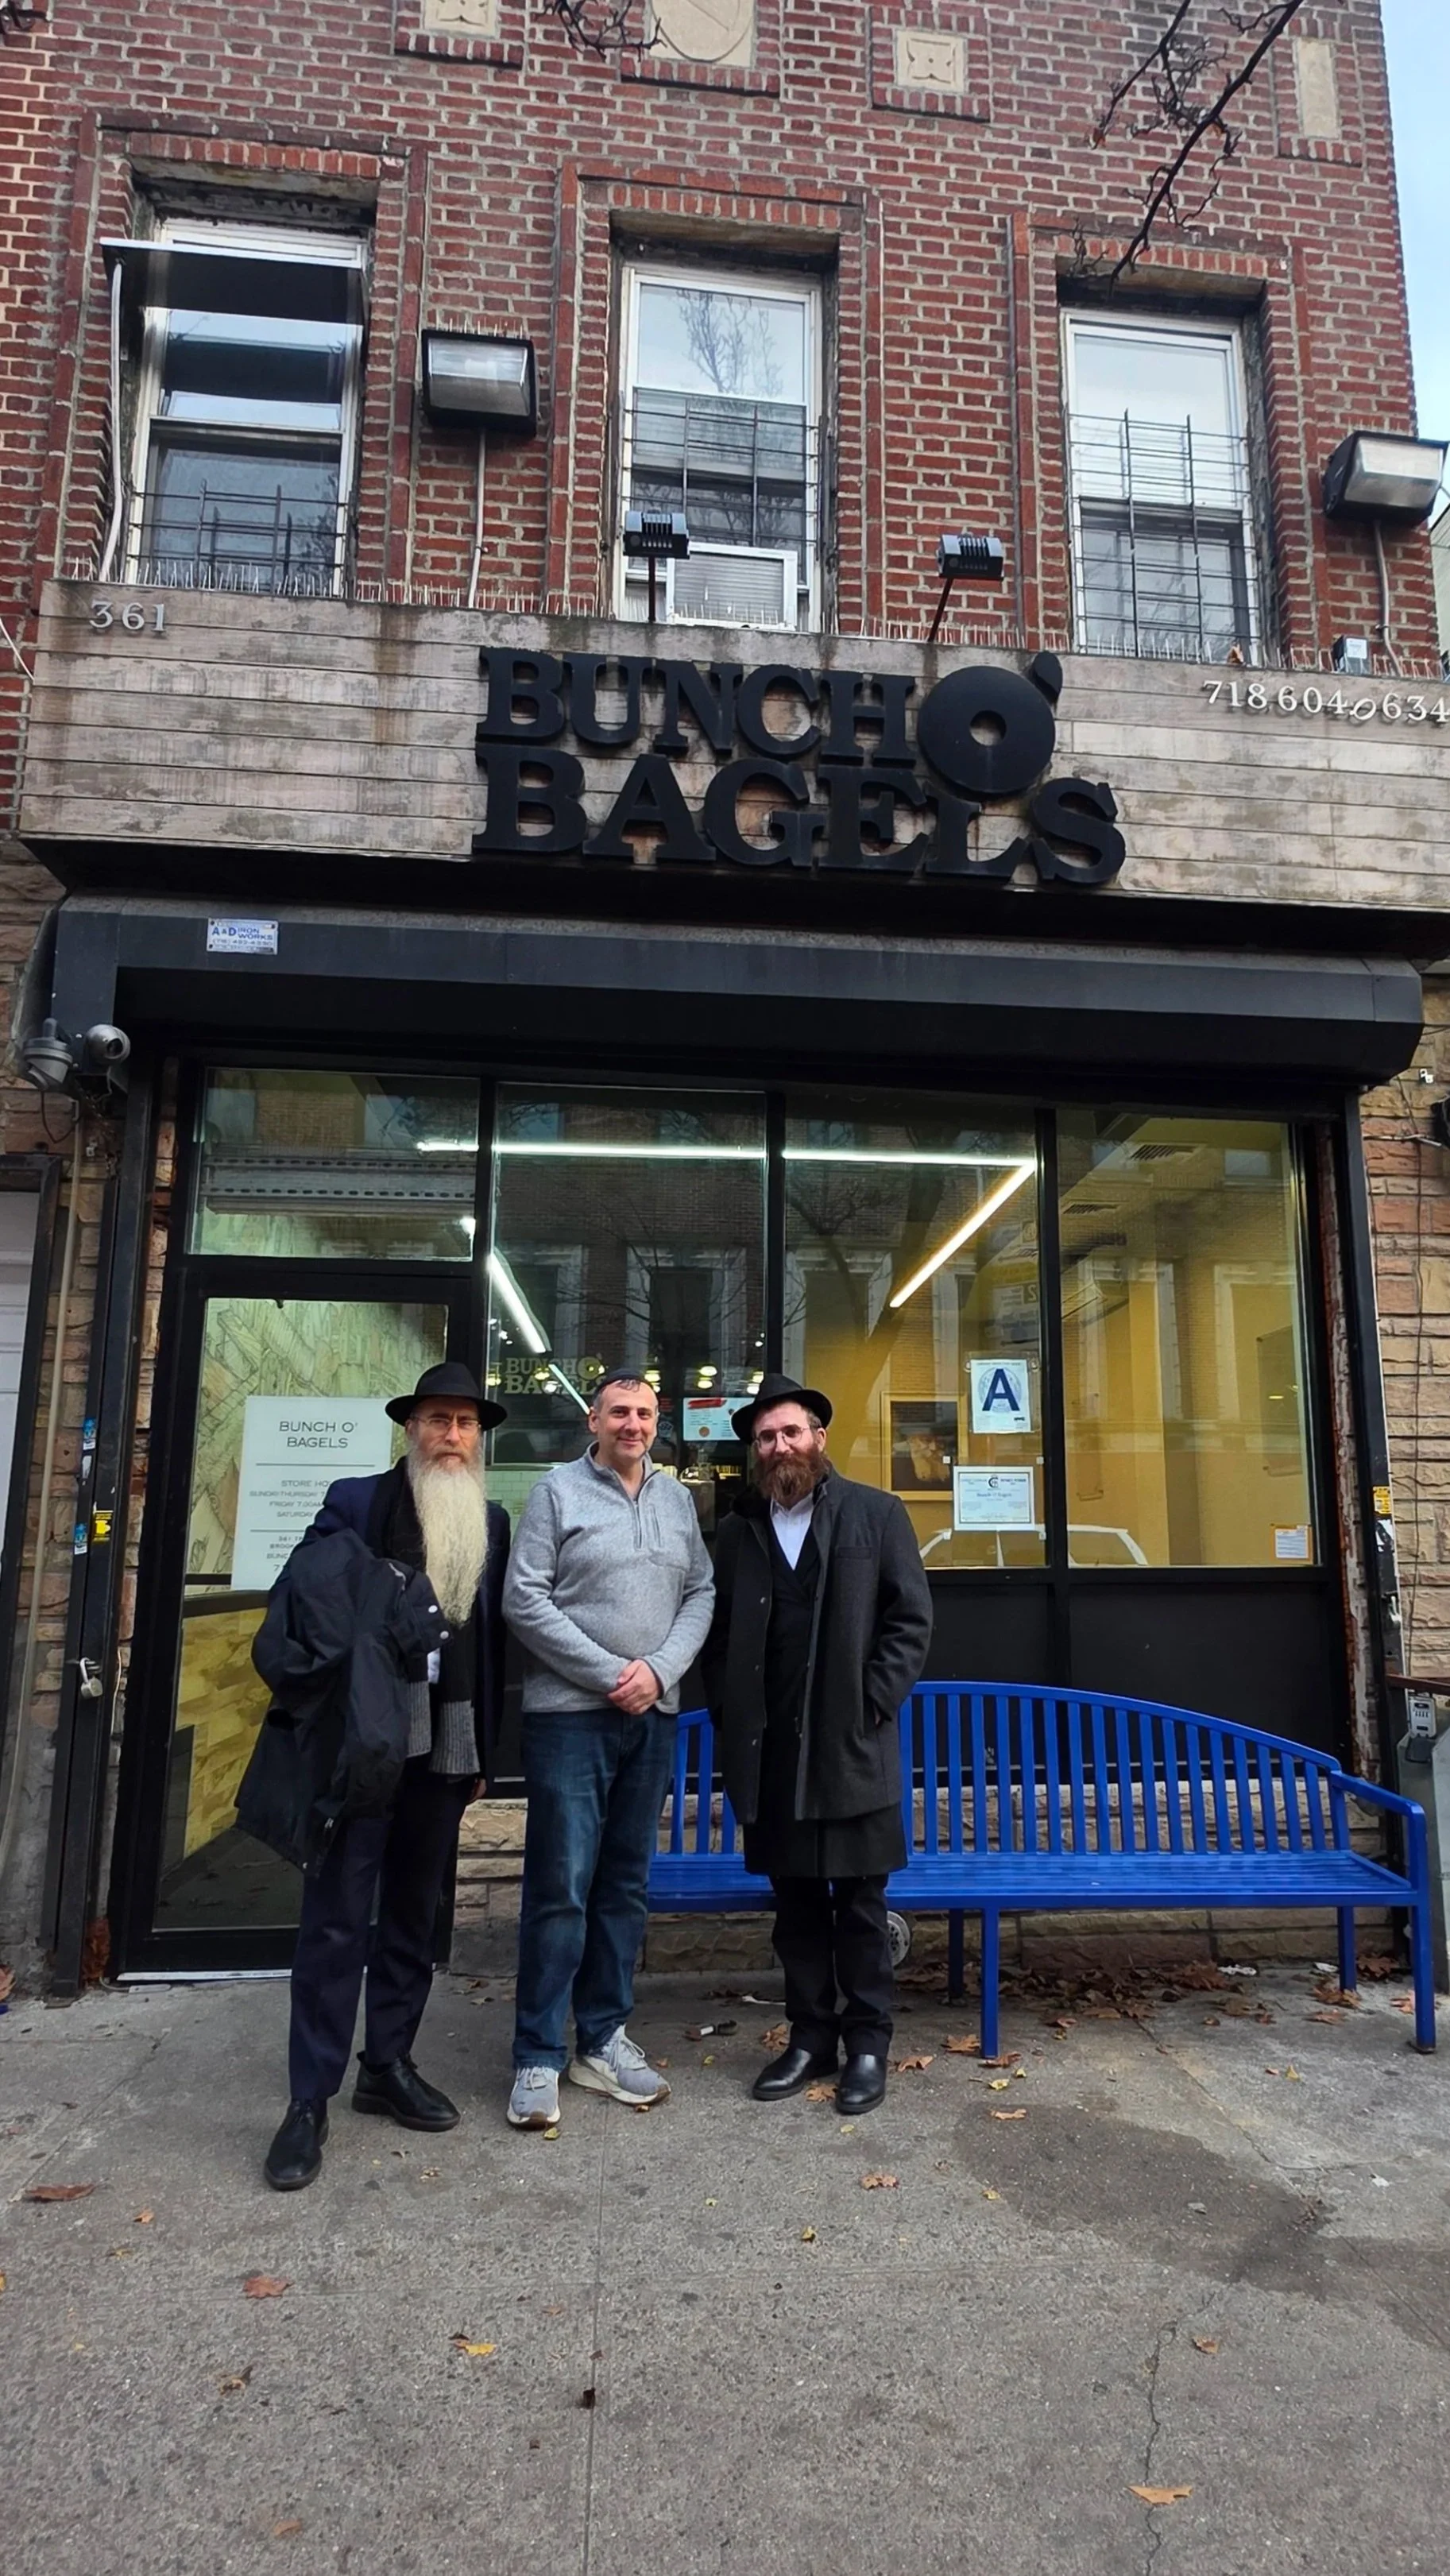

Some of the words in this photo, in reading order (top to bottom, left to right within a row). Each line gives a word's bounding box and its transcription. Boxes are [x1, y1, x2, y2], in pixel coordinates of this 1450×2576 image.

[89, 600, 166, 631] 361
[476, 646, 916, 768] BUNCH
[472, 744, 1127, 884] BAGELS
[982, 1368, 1020, 1411] A
[279, 1421, 336, 1432] BUNCH
[287, 1437, 348, 1449] BAGELS
